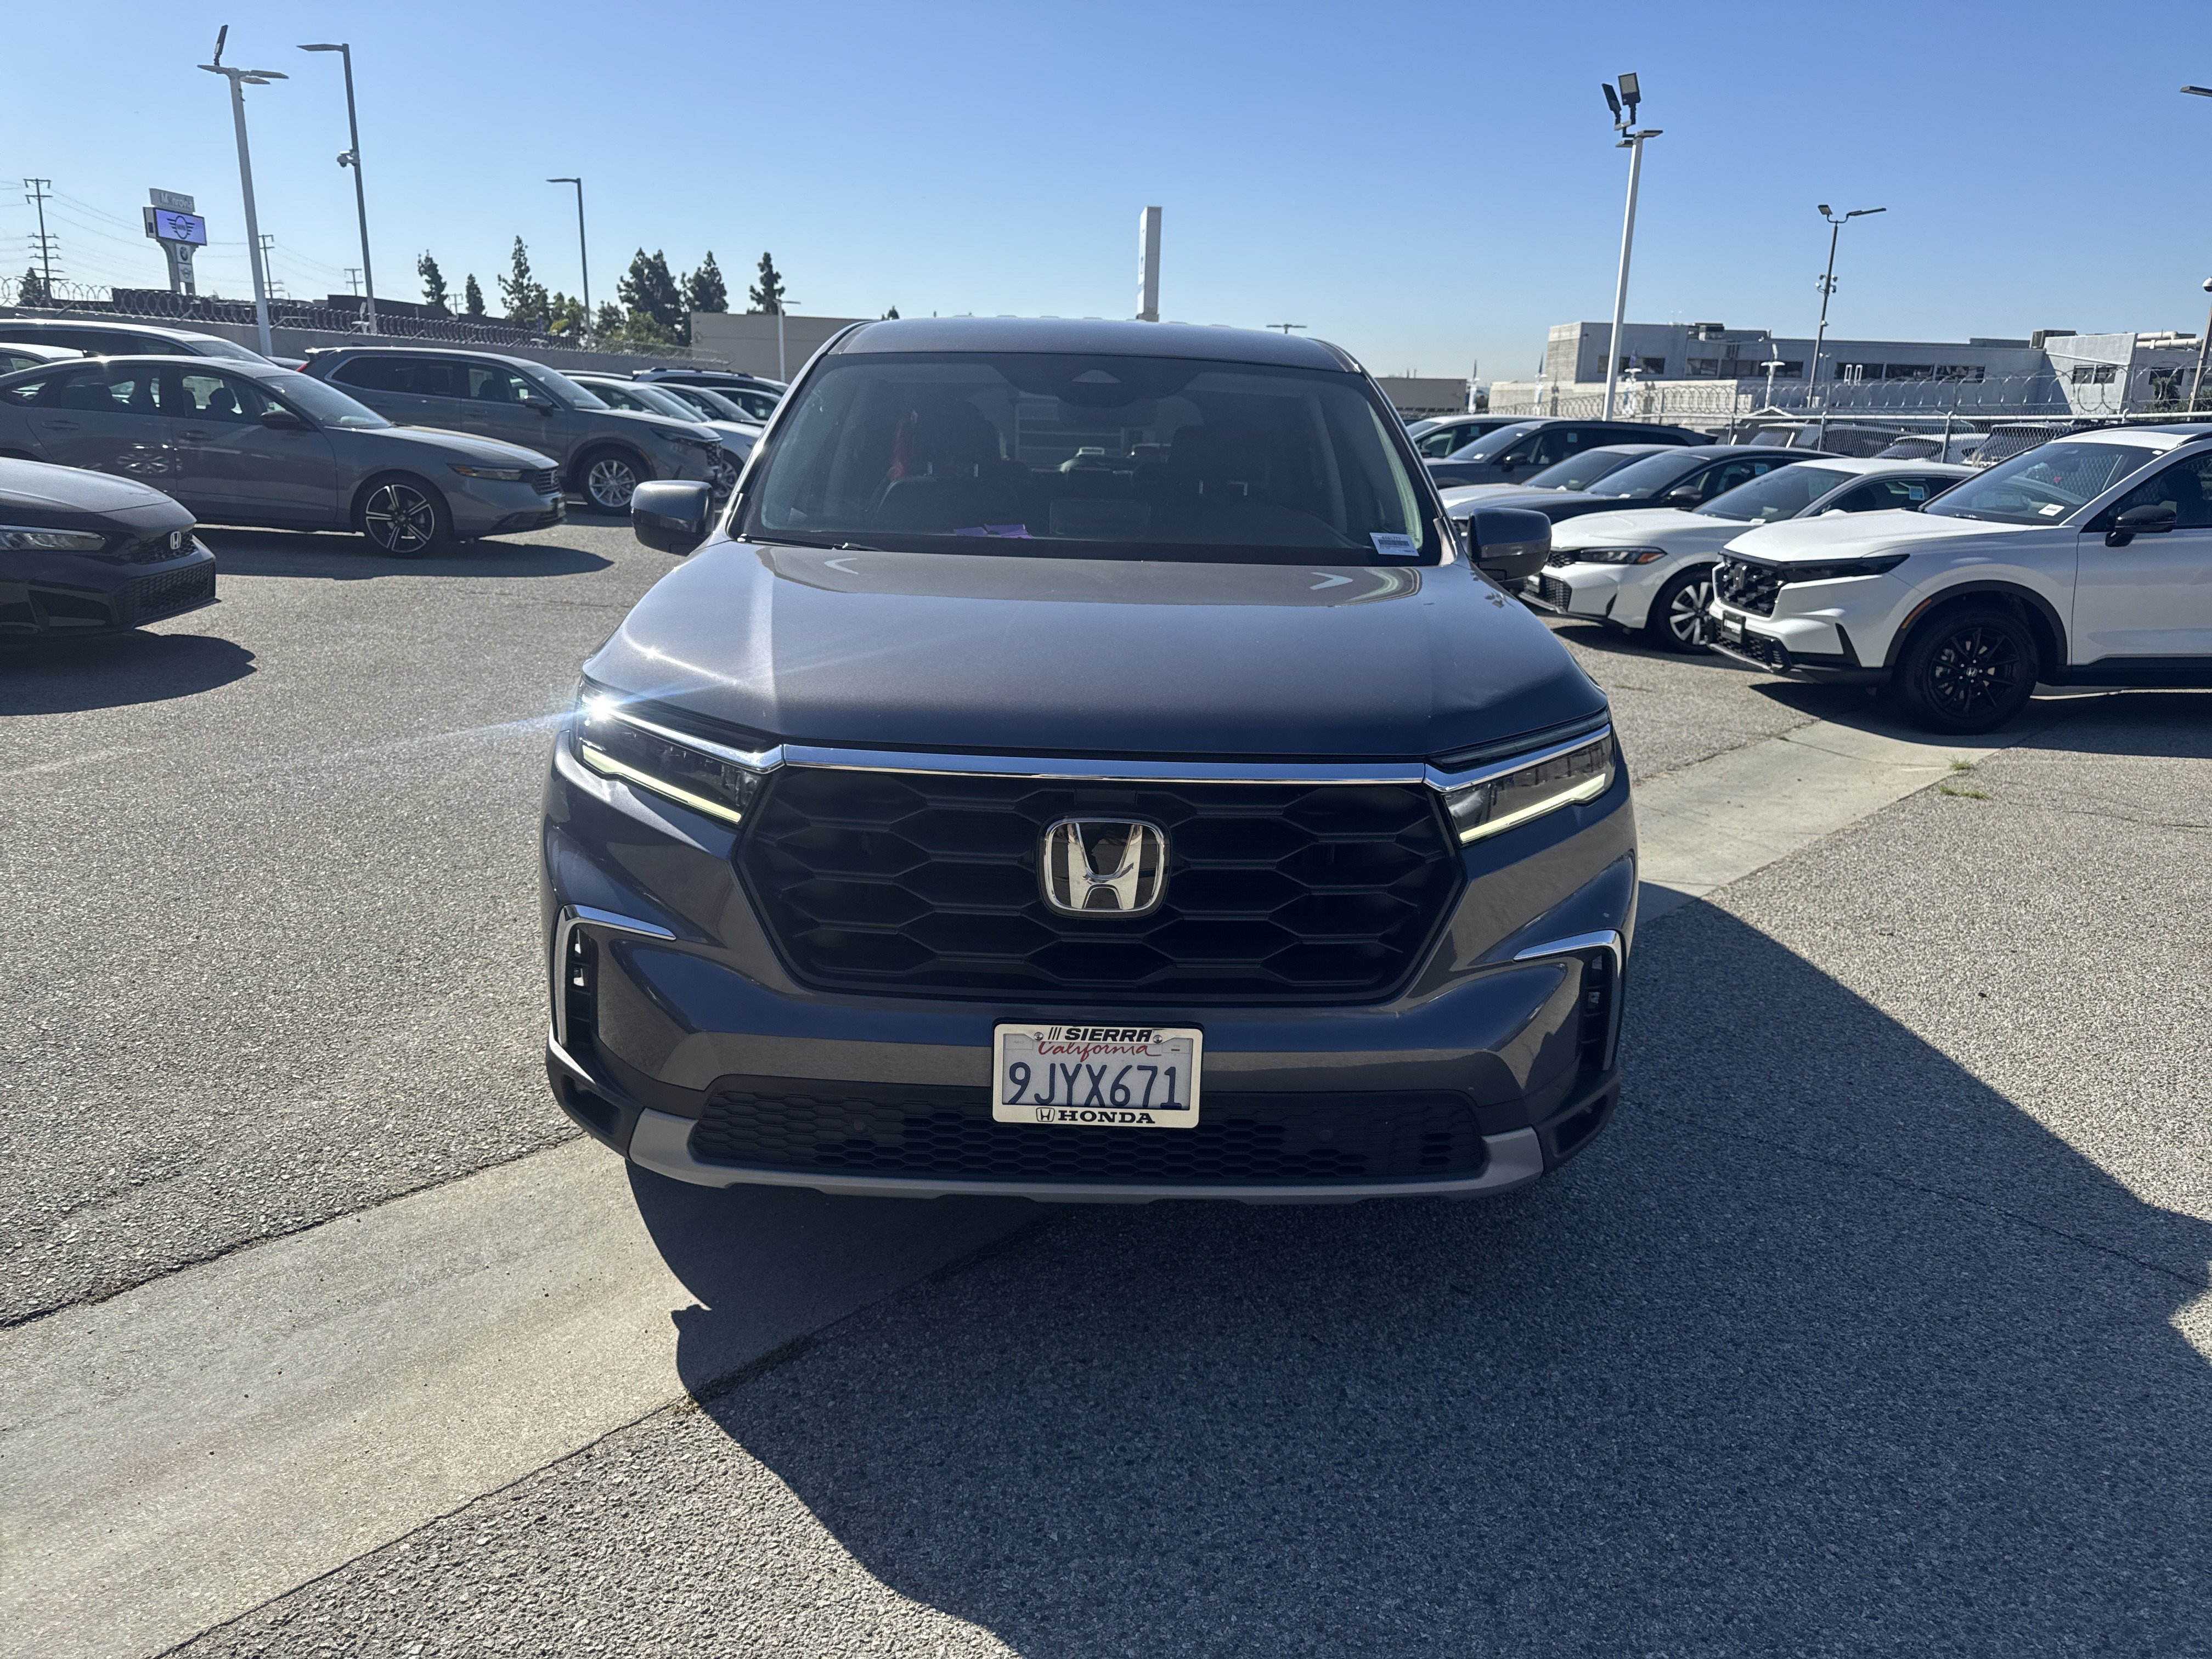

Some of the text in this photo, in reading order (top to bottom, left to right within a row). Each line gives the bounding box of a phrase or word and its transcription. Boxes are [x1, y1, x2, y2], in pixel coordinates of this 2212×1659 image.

[1067, 822, 1143, 910] H
[1064, 1027, 1152, 1042] SIERRA
[1038, 1041, 1161, 1062] California
[1008, 1062, 1182, 1109] 9JYX671
[1058, 1110, 1155, 1124] HONDA
